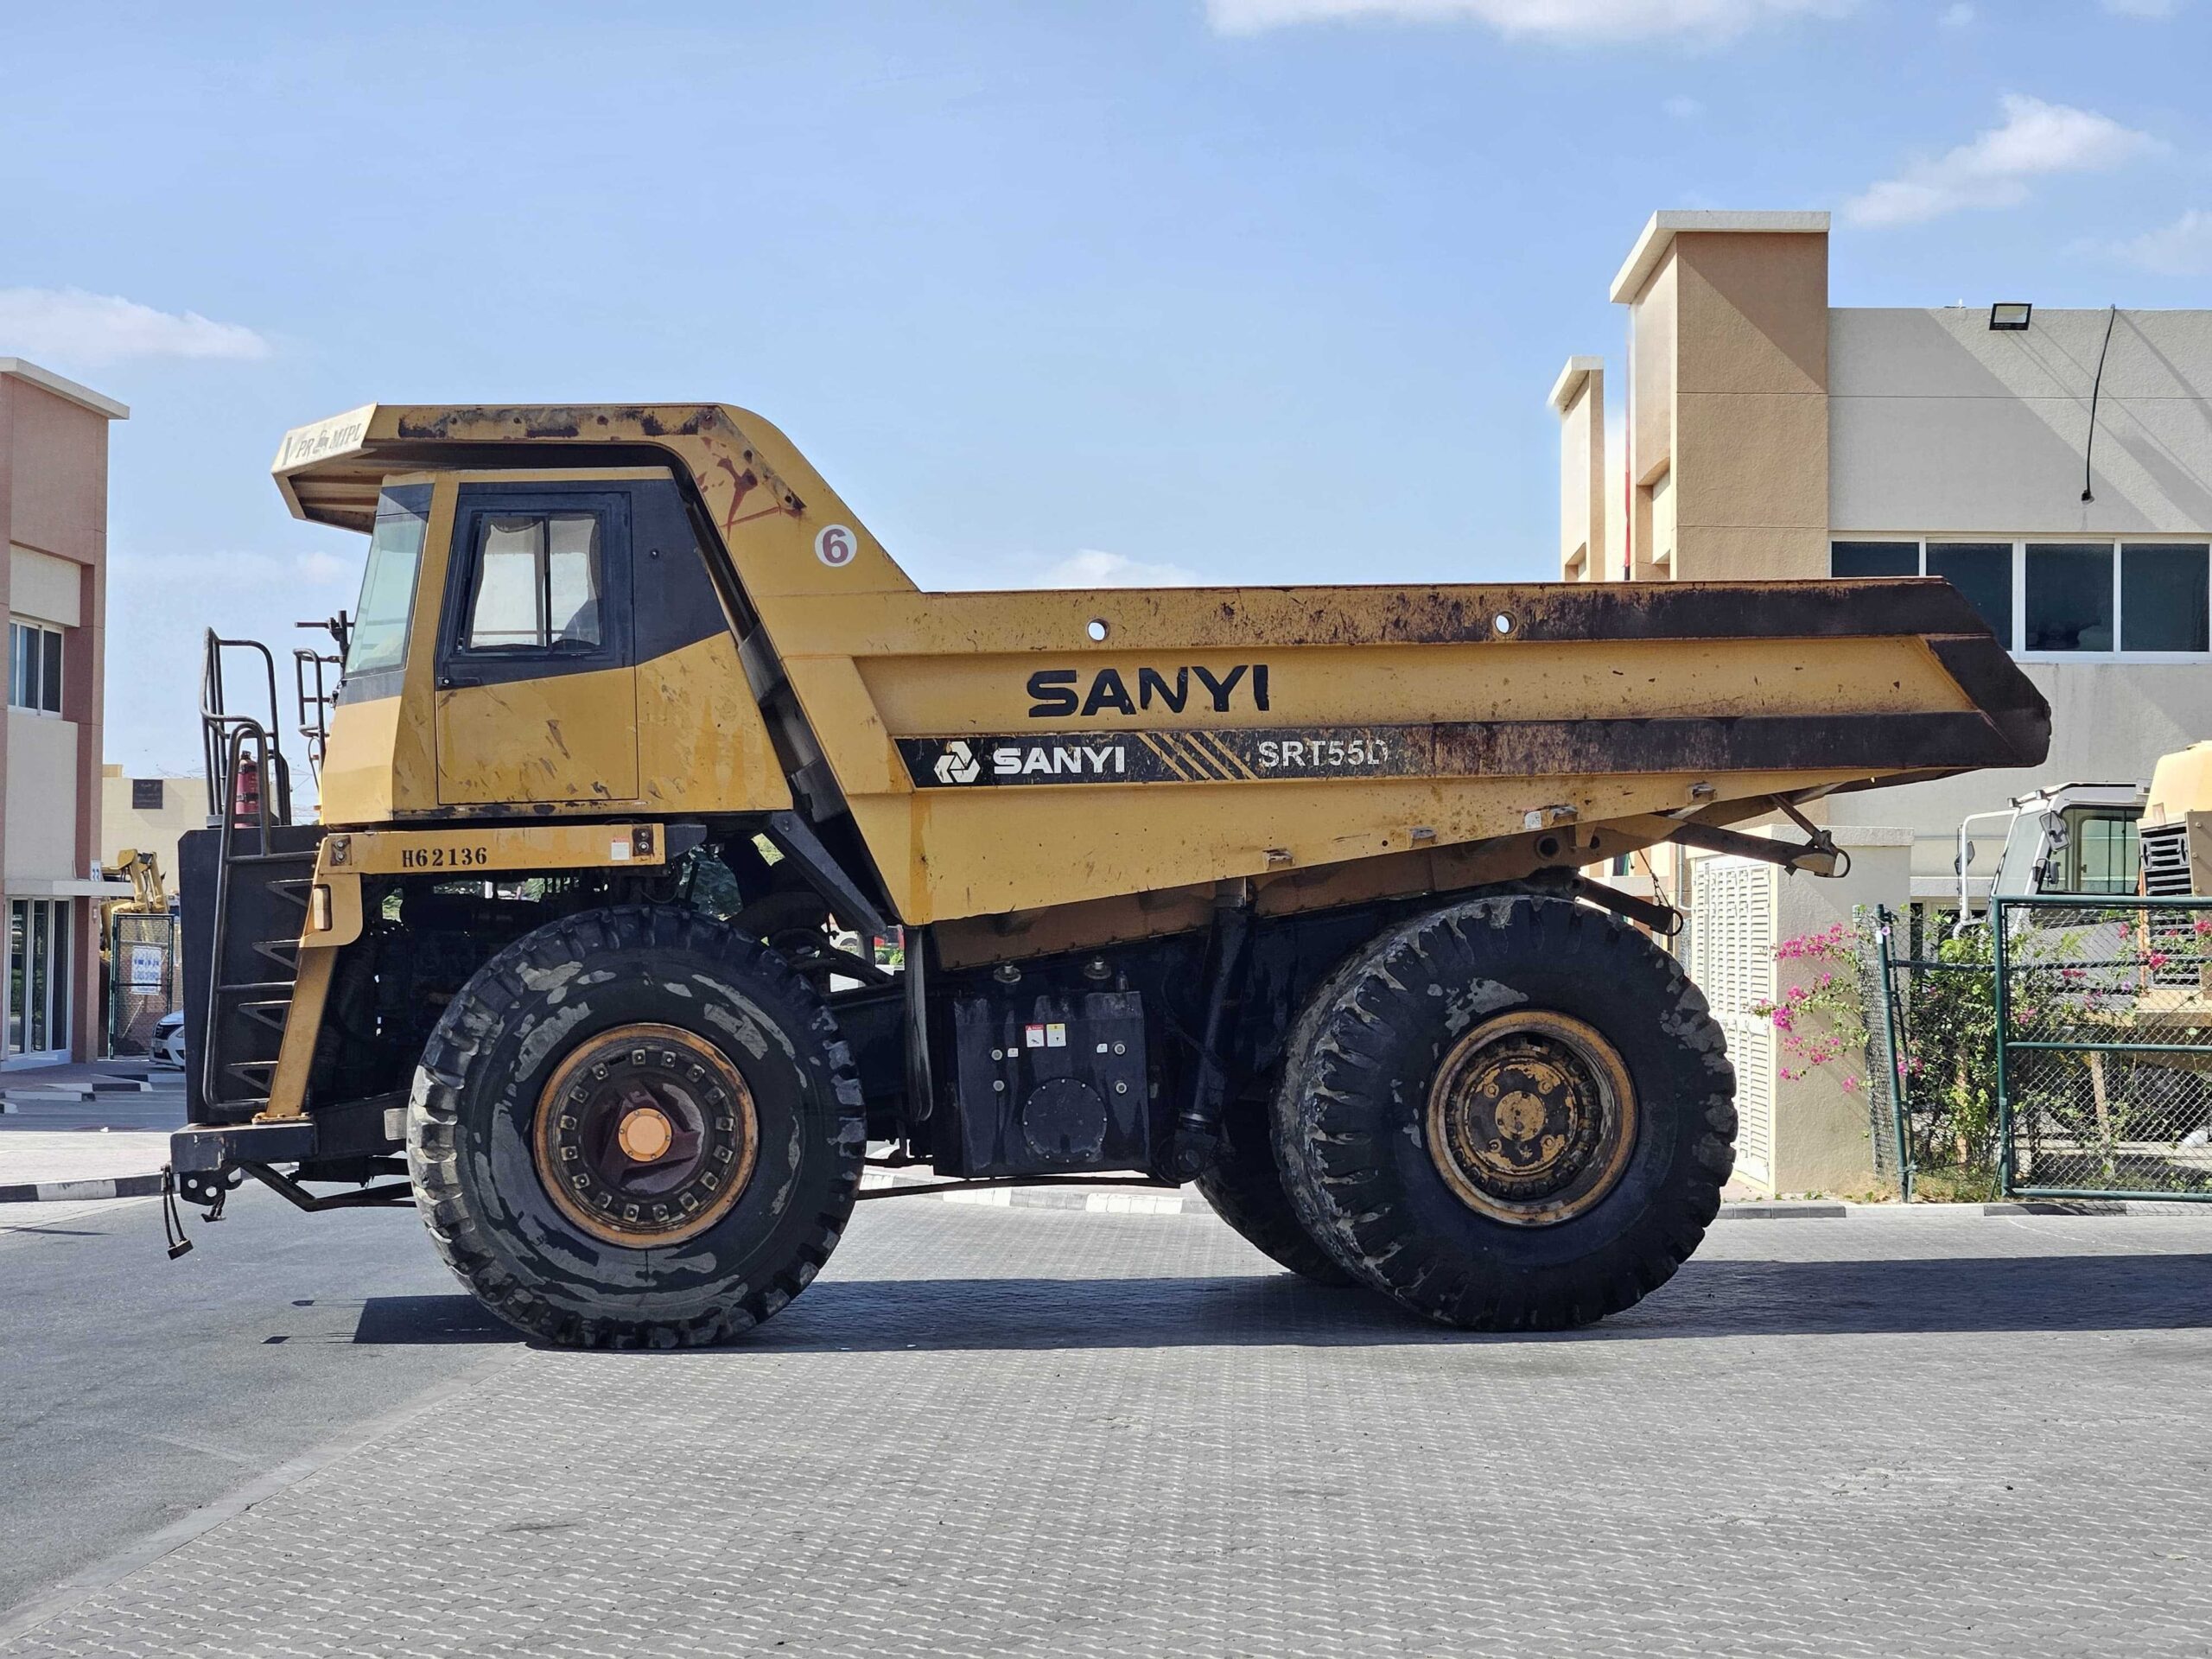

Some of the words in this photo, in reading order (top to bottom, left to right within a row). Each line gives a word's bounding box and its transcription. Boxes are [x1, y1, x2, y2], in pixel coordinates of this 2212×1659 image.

[822, 528, 849, 564] 6
[1027, 664, 1269, 718] SANYI
[993, 747, 1125, 775] SANYI
[402, 847, 487, 868] H62136
